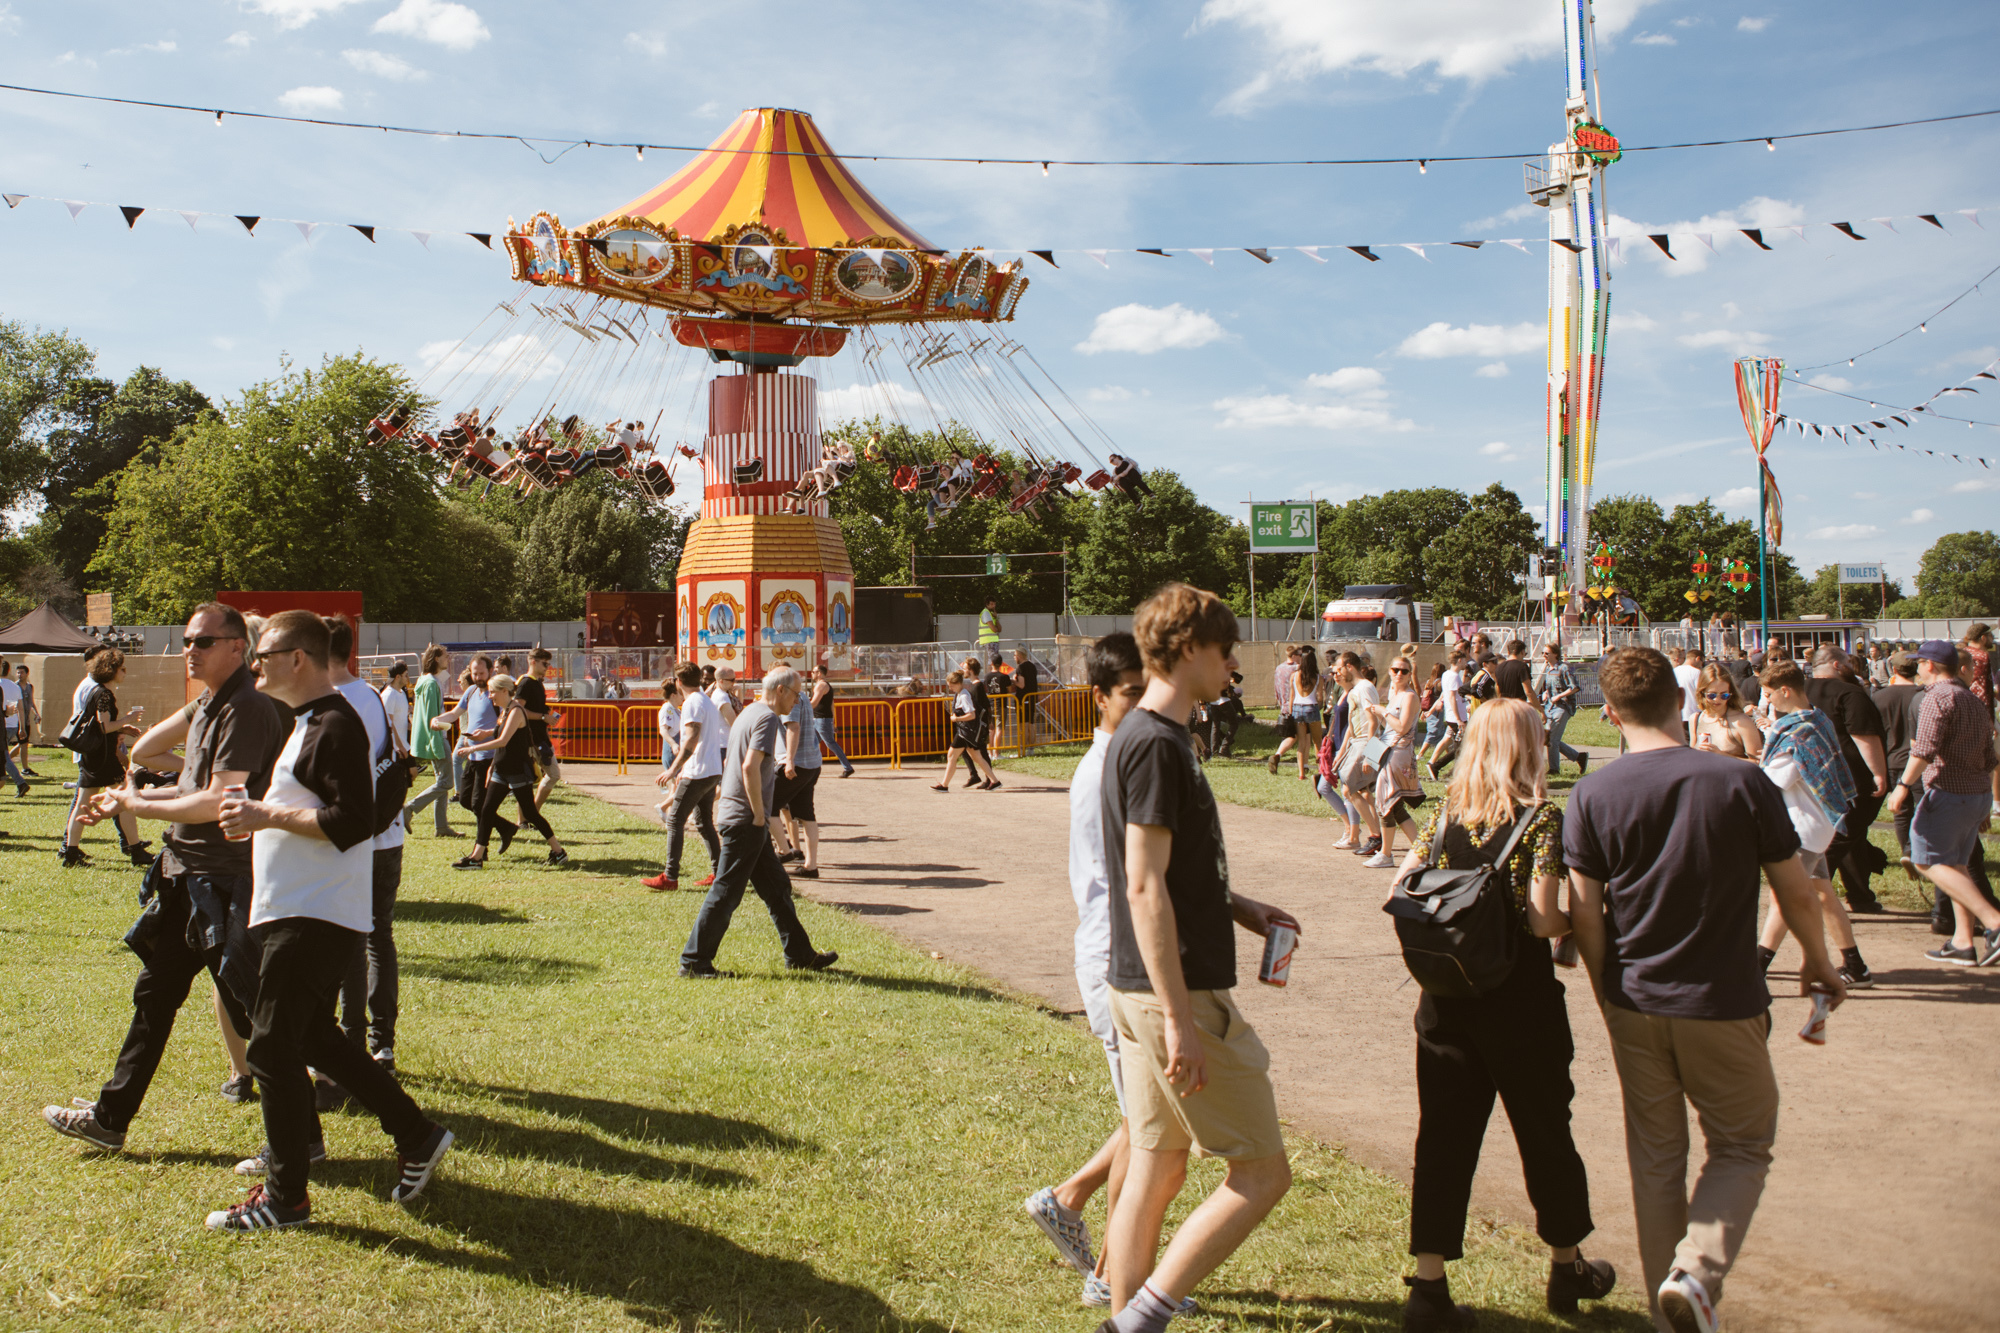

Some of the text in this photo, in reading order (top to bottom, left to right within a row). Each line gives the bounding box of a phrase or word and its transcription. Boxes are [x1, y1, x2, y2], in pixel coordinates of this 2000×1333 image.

[1576, 129, 1619, 153] SPEED
[1257, 510, 1282, 522] Fire
[1258, 525, 1282, 536] exit
[990, 563, 1003, 574] 12
[1845, 567, 1878, 578] TOILETS
[619, 668, 638, 676] EXIT
